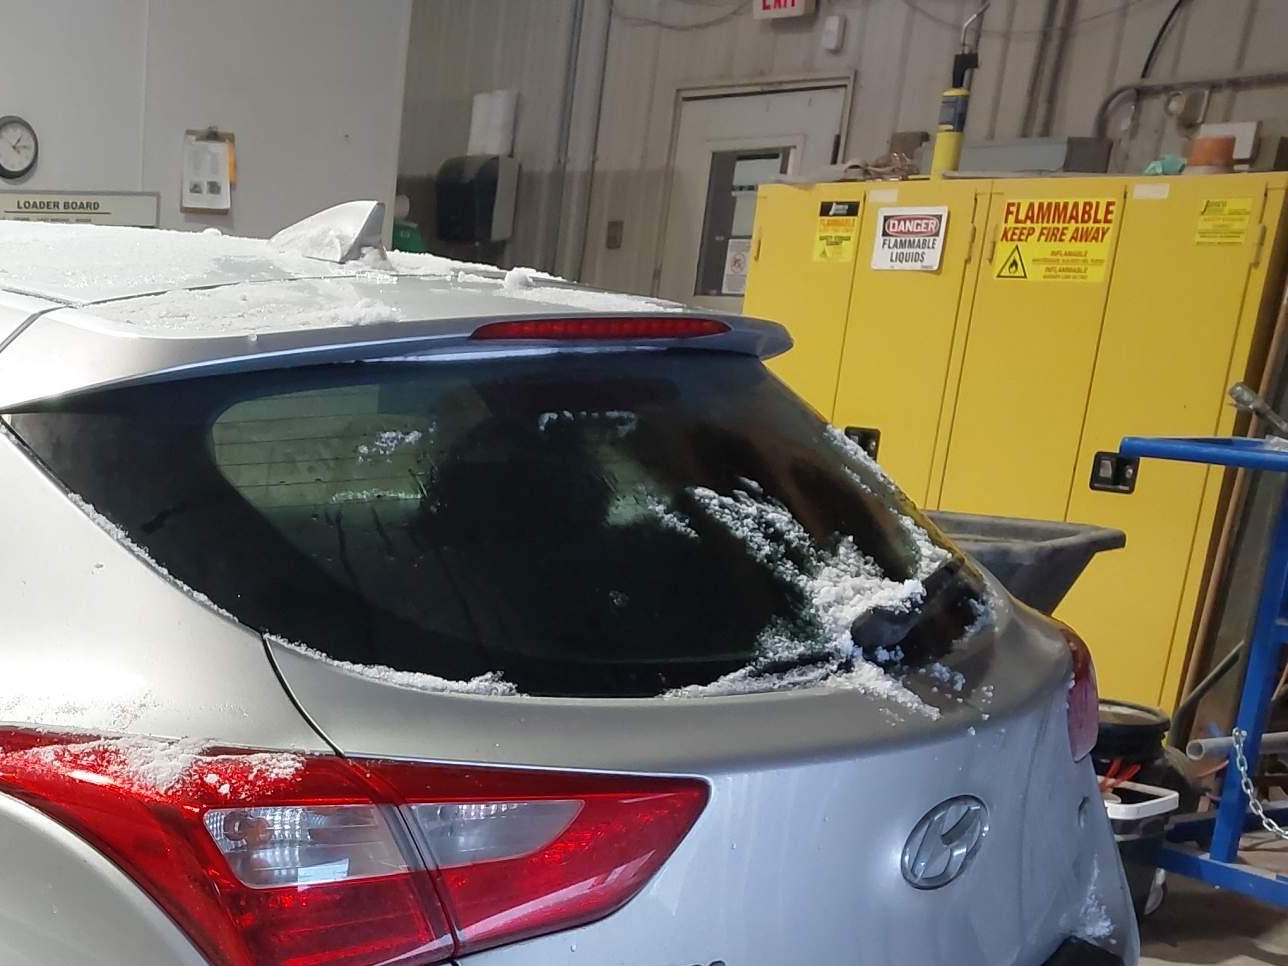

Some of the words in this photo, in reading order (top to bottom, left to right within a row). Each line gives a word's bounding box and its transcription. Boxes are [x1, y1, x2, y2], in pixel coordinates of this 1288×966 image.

[17, 200, 60, 210] LOADER
[63, 201, 100, 211] BOARD
[1004, 200, 1116, 225] FLAMMABLE
[889, 219, 937, 235] DANGER
[1000, 226, 1036, 242] KEEP
[1037, 226, 1069, 242] FIRE
[1069, 226, 1111, 243] AWAY
[881, 238, 937, 250] FLAMMABLE
[889, 251, 926, 264] LIQUIDS
